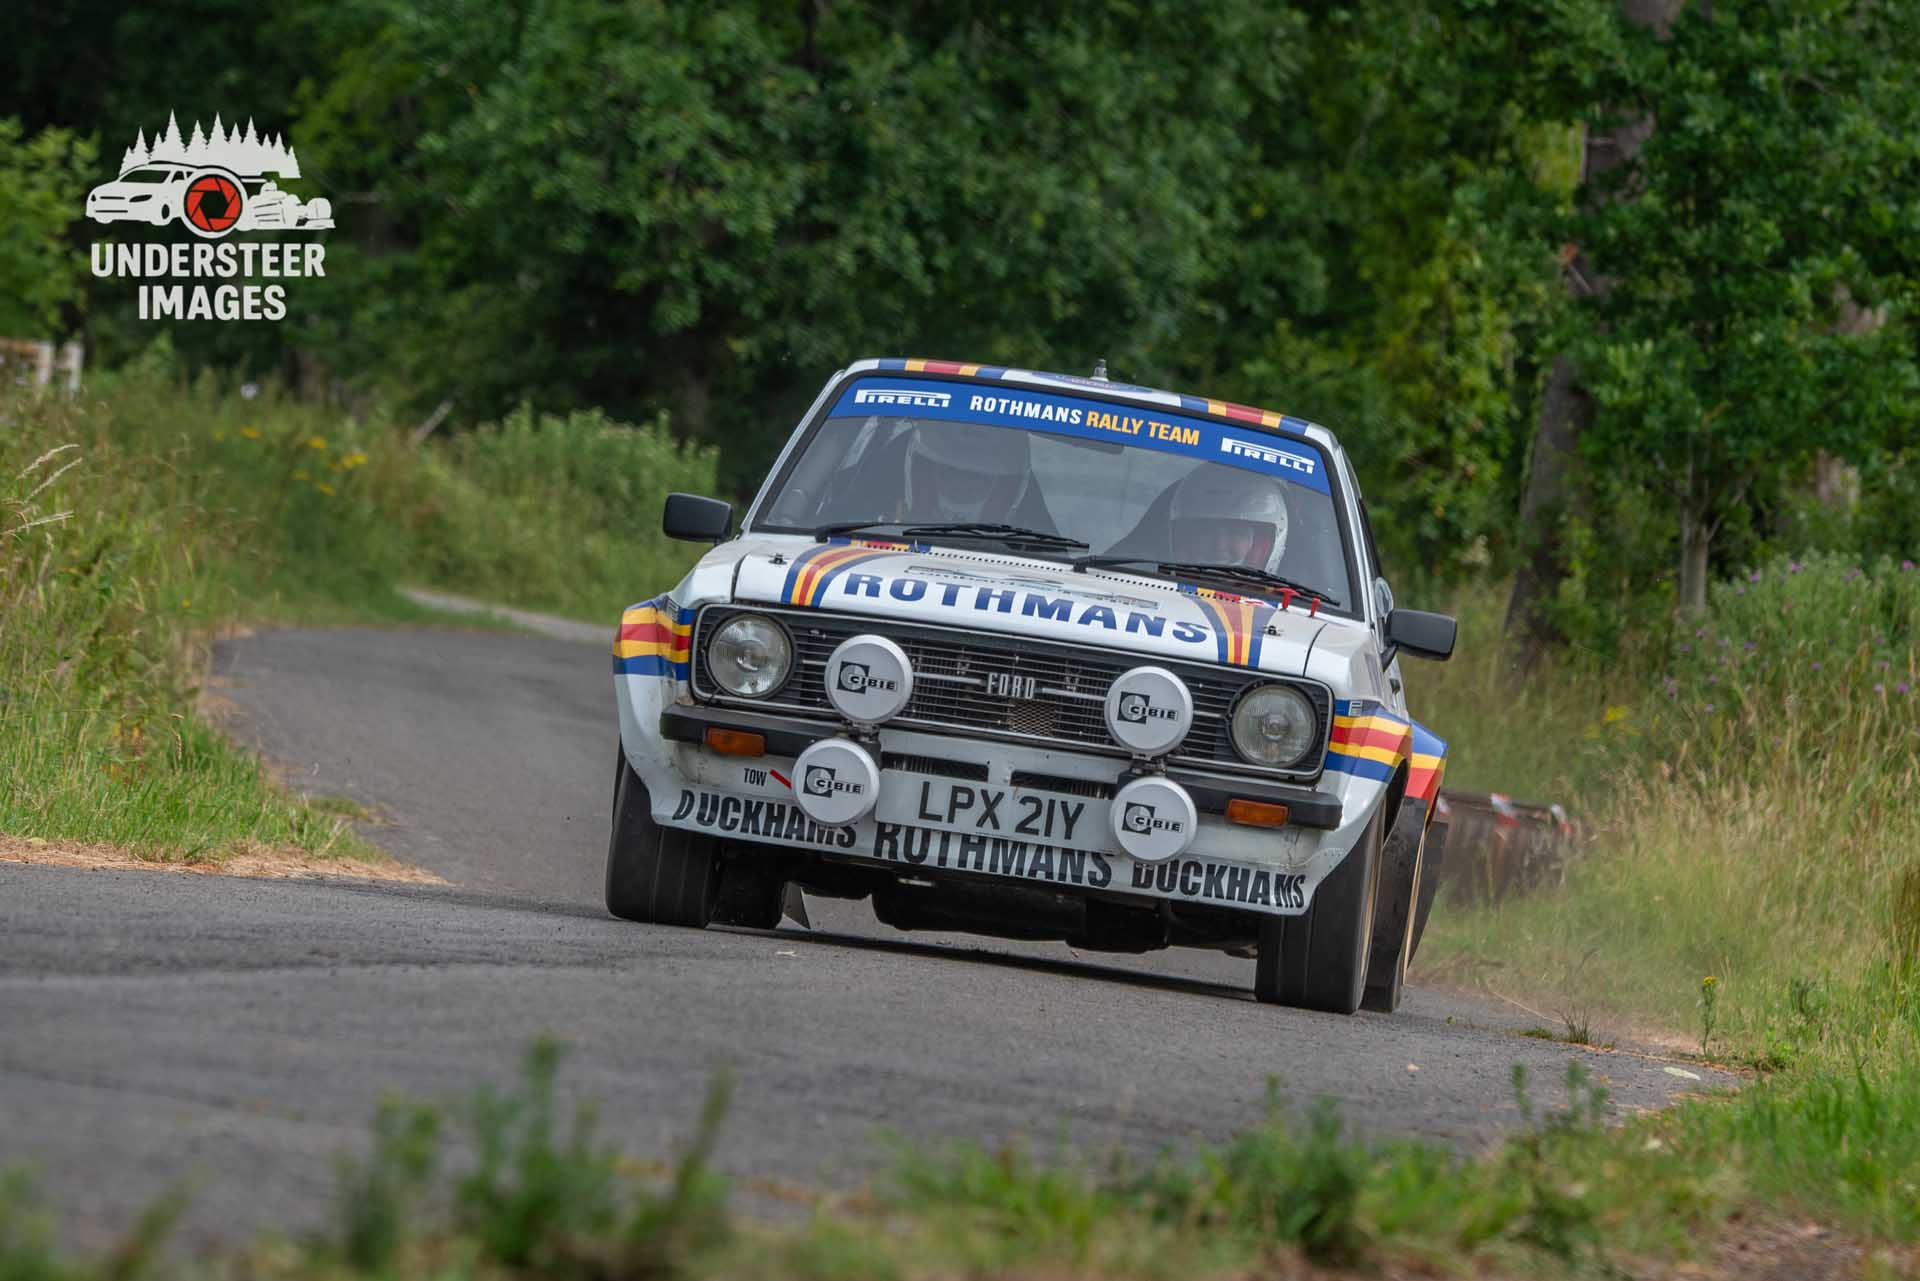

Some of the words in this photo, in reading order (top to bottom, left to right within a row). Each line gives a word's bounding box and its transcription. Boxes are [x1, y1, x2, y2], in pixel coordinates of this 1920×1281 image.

[855, 389, 952, 408] PIRELLI
[969, 395, 1083, 425] ROTHMANS
[1086, 410, 1144, 435] RALLY
[1148, 420, 1201, 446] TEAM
[1221, 437, 1315, 474] PIRELLI
[843, 573, 1211, 643] ROTHMANS
[987, 672, 1035, 700] FORD
[743, 767, 767, 787] TOW
[918, 781, 1005, 830] LPX
